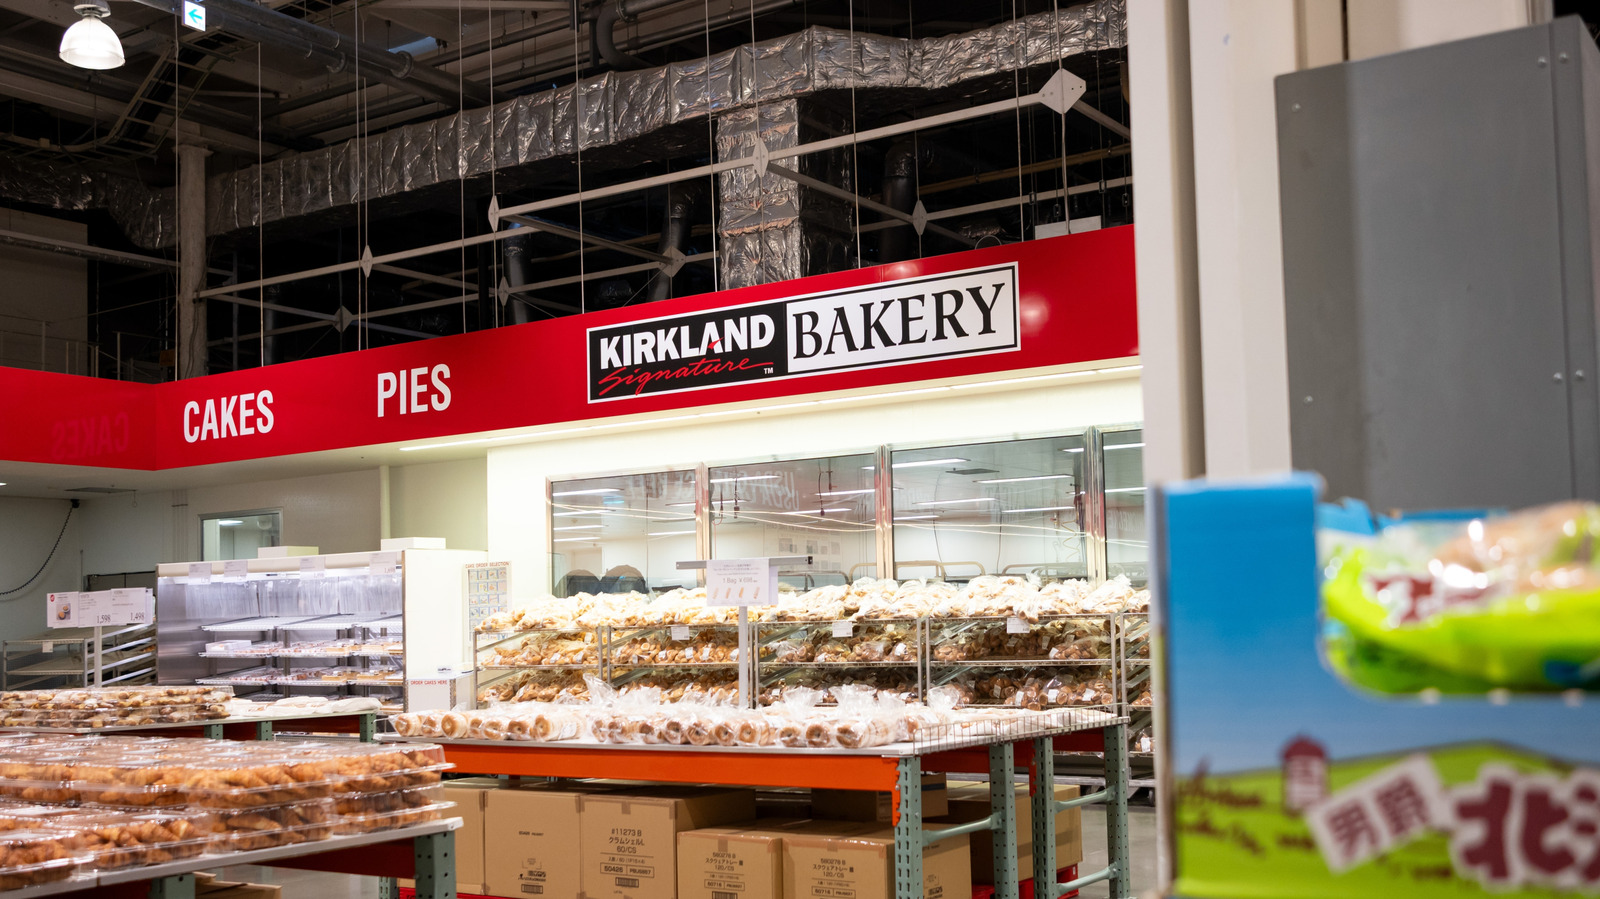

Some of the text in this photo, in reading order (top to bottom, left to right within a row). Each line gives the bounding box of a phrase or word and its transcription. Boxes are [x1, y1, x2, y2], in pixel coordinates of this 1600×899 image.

[792, 283, 1006, 361] BAKERY
[600, 314, 778, 371] KIRKLAND
[377, 363, 452, 418] PIES
[598, 358, 777, 397] Signature
[183, 389, 275, 444] CAKES
[96, 614, 111, 624] 1,598
[608, 837, 645, 845] クラムシェルL
[611, 828, 636, 836] #11273
[616, 845, 637, 853] 60/CS
